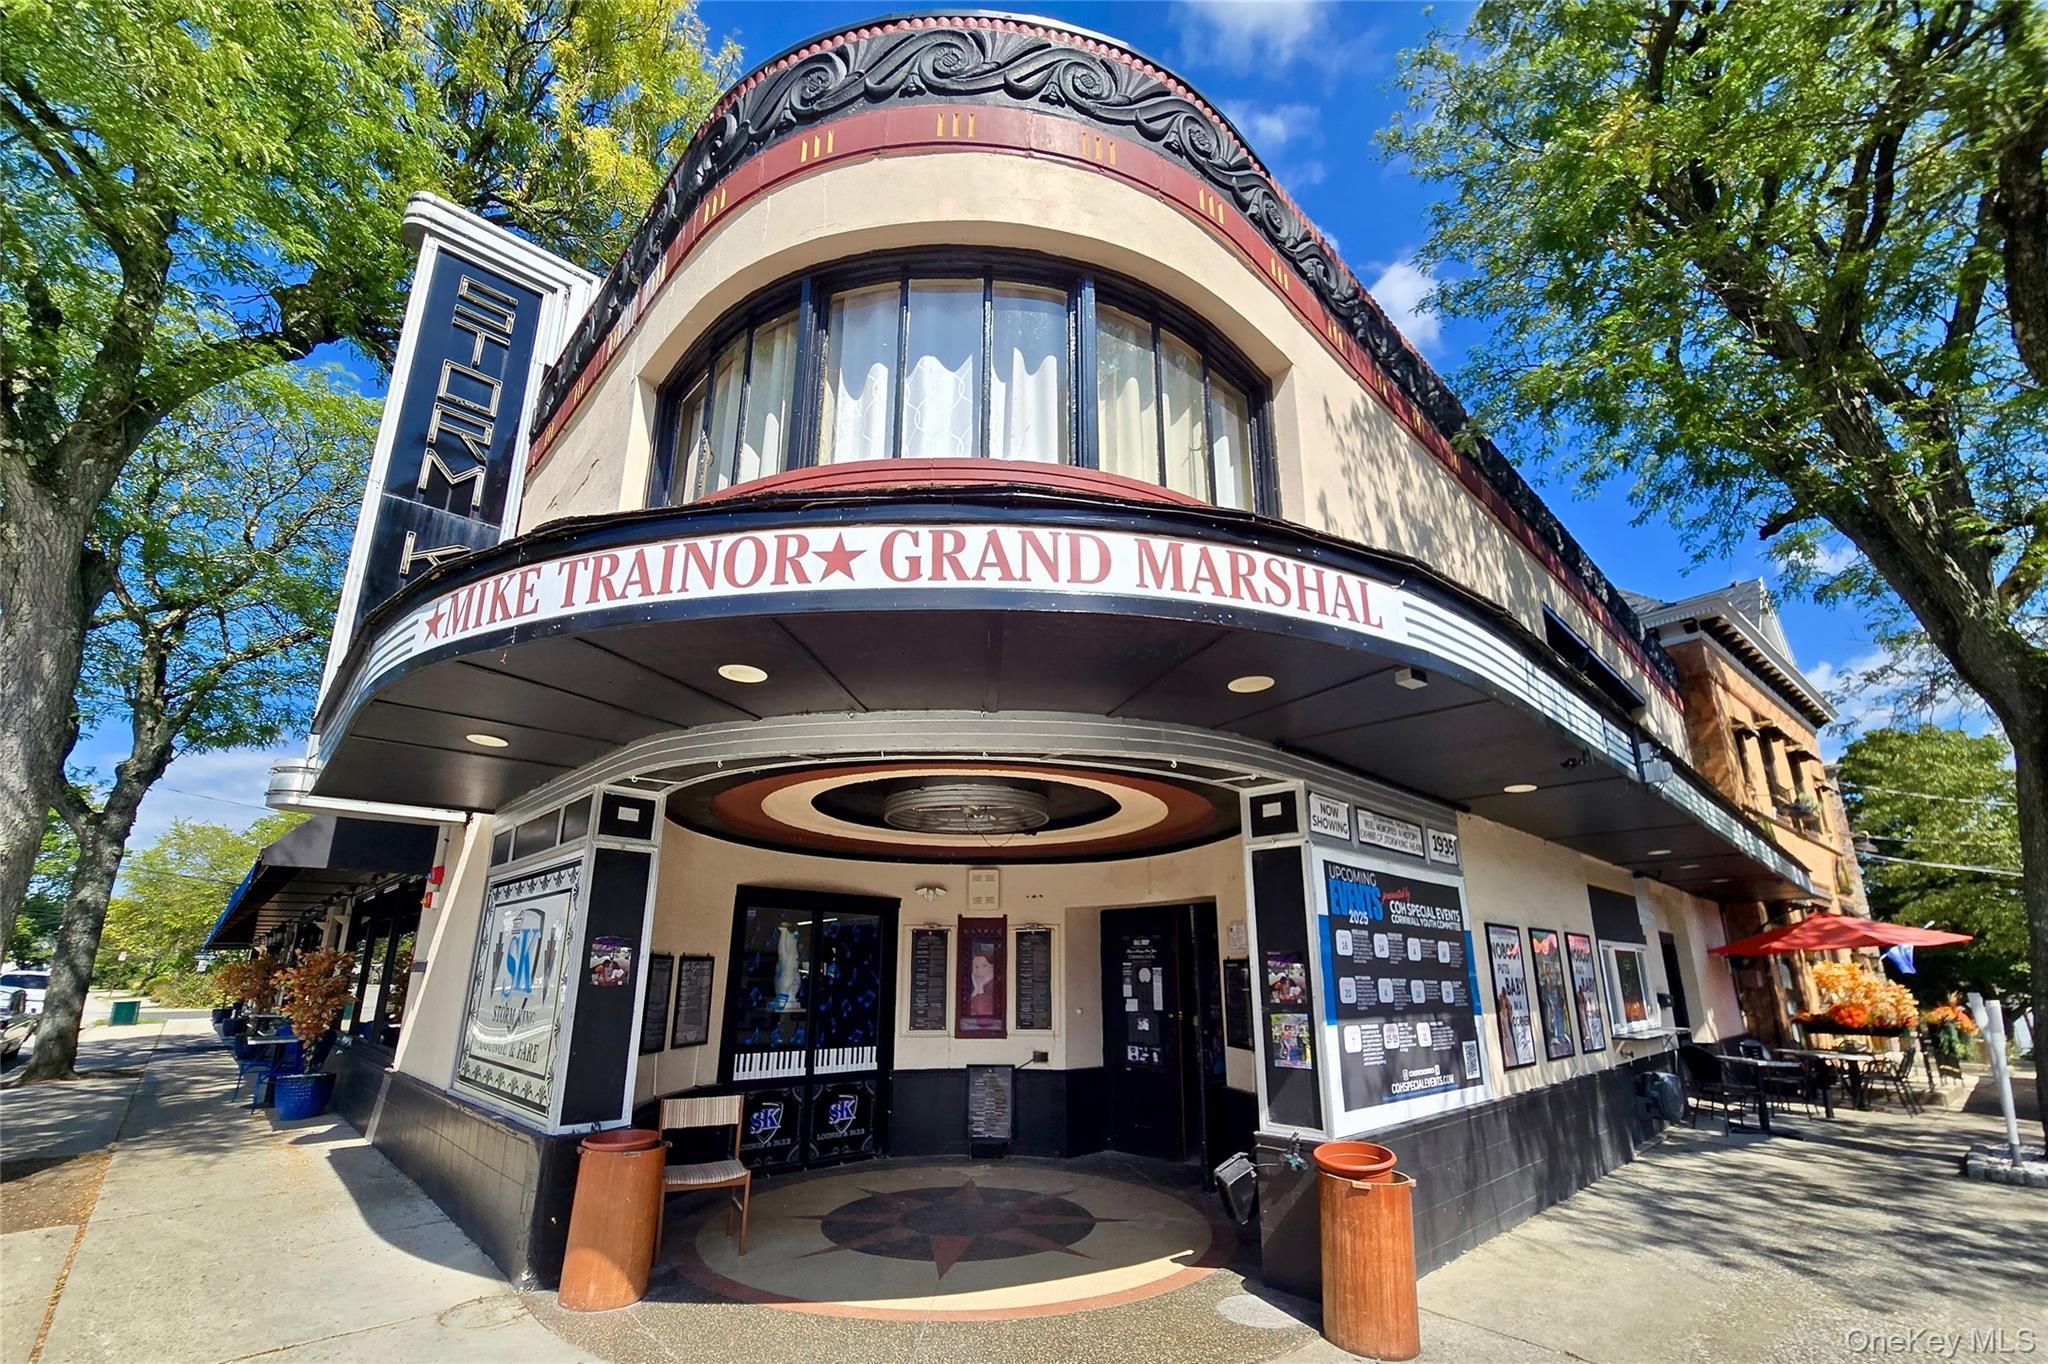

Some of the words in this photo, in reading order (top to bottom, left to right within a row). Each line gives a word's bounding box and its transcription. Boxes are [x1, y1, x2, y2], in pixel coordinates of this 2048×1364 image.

[415, 274, 519, 511] STORM
[442, 566, 542, 638] MIKE
[558, 532, 812, 609] TRAINOR
[879, 528, 1113, 585] GRAND
[1133, 536, 1385, 631] MARSHAL
[1319, 802, 1339, 818] NOW
[1312, 814, 1348, 836] SHOWING
[1432, 835, 1455, 855] 1935
[1328, 865, 1377, 887] UPCOMING
[1329, 877, 1384, 921] EVENTS
[1348, 909, 1369, 926] 2025
[1389, 899, 1407, 915] COH
[1407, 902, 1436, 919] SPECIAL
[1436, 907, 1460, 922] EVENTS
[1504, 977, 1525, 997] BABY
[491, 1002, 516, 1027] STORM
[508, 1042, 515, 1058] &
[516, 1042, 540, 1063] FARE
[1391, 1074, 1455, 1094] COHSPECIALEVENTS.COM
[749, 1107, 781, 1135] SK
[828, 1099, 857, 1125] SK
